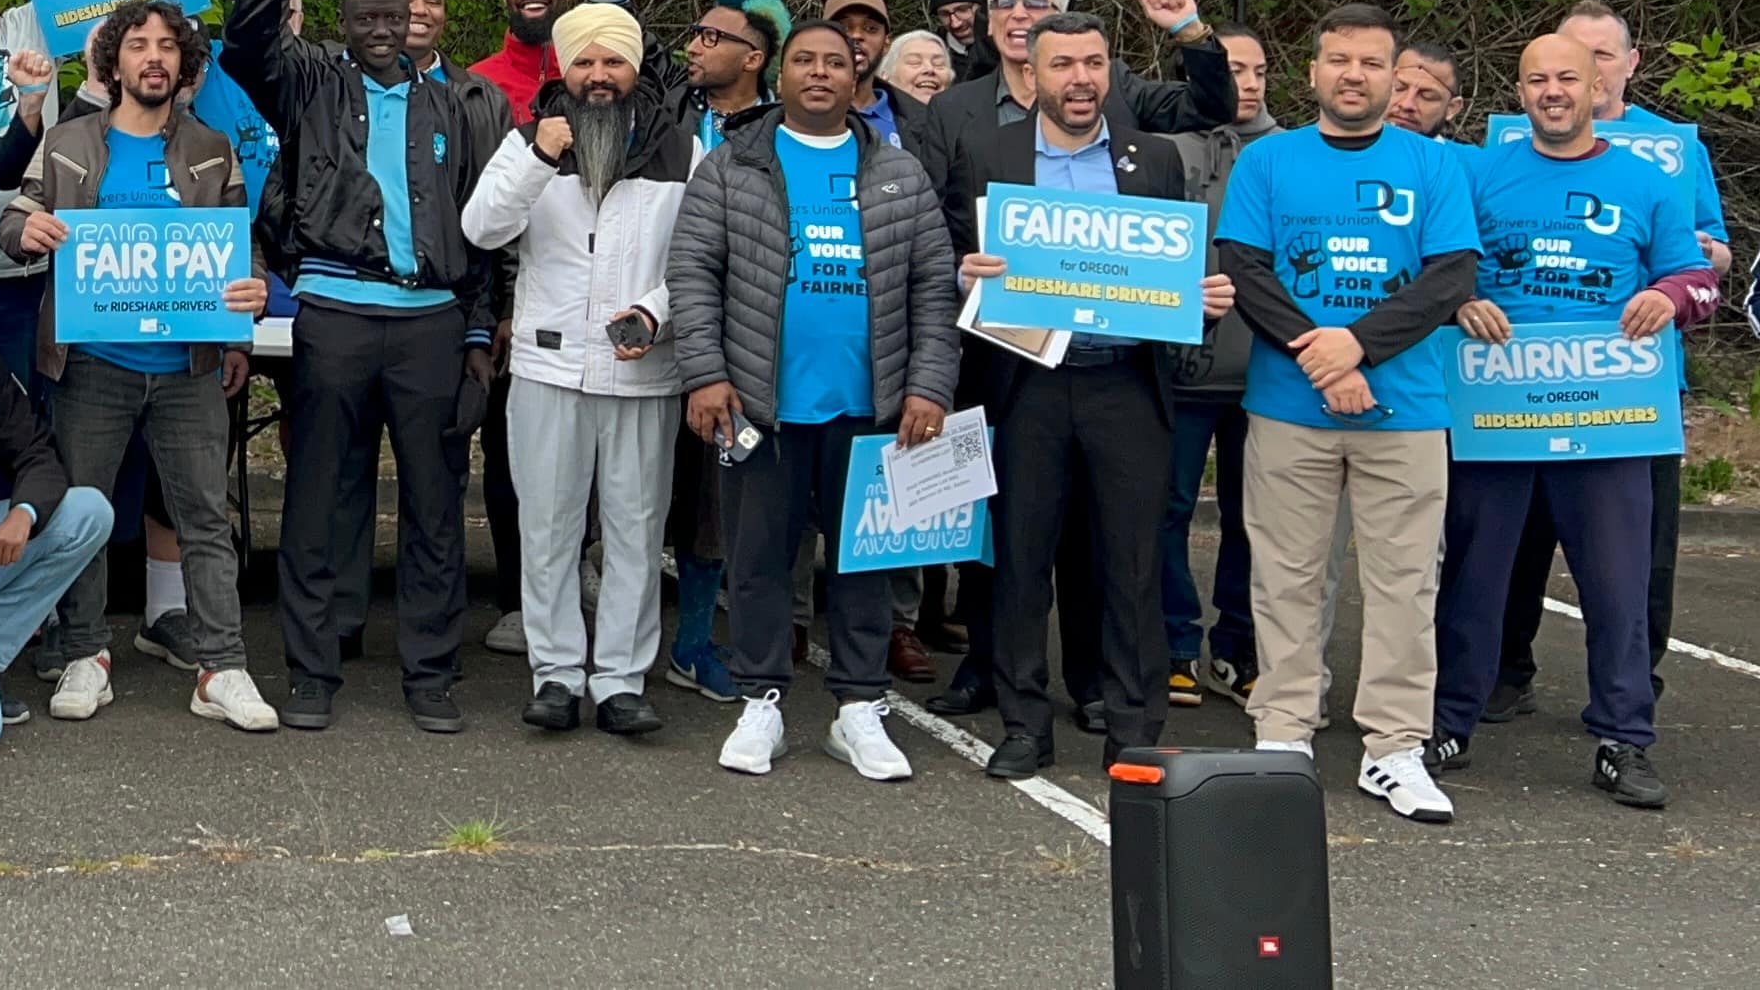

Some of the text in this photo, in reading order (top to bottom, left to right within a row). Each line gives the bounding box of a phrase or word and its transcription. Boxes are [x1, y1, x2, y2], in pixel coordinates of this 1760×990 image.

[131, 190, 166, 202] Union
[812, 204, 853, 216] Union
[1281, 214, 1381, 227] Drivers Union
[1542, 219, 1585, 232] Union
[805, 224, 844, 239] OUR
[1005, 203, 1189, 256] FAIRNESS
[808, 244, 862, 259] VOICE
[1327, 237, 1370, 252] OUR
[1532, 238, 1572, 253] OUR
[76, 241, 234, 280] FAIR PAY
[1060, 260, 1129, 276] for OREGON
[1331, 257, 1388, 273] VOICE
[1535, 255, 1588, 271] VOICE
[812, 263, 847, 276] FOR
[1534, 270, 1570, 284] FOR
[1004, 276, 1181, 307] RIDESHARE DRIVERS
[1334, 277, 1372, 291] FOR
[1522, 284, 1609, 305] FAIRNESS
[94, 300, 217, 312] for RIDESHARE DRIVERS
[1463, 337, 1658, 379] FAIRNESS
[1527, 390, 1599, 403] for OREGON
[1473, 406, 1657, 429] RIDESHARE DRIVERS
